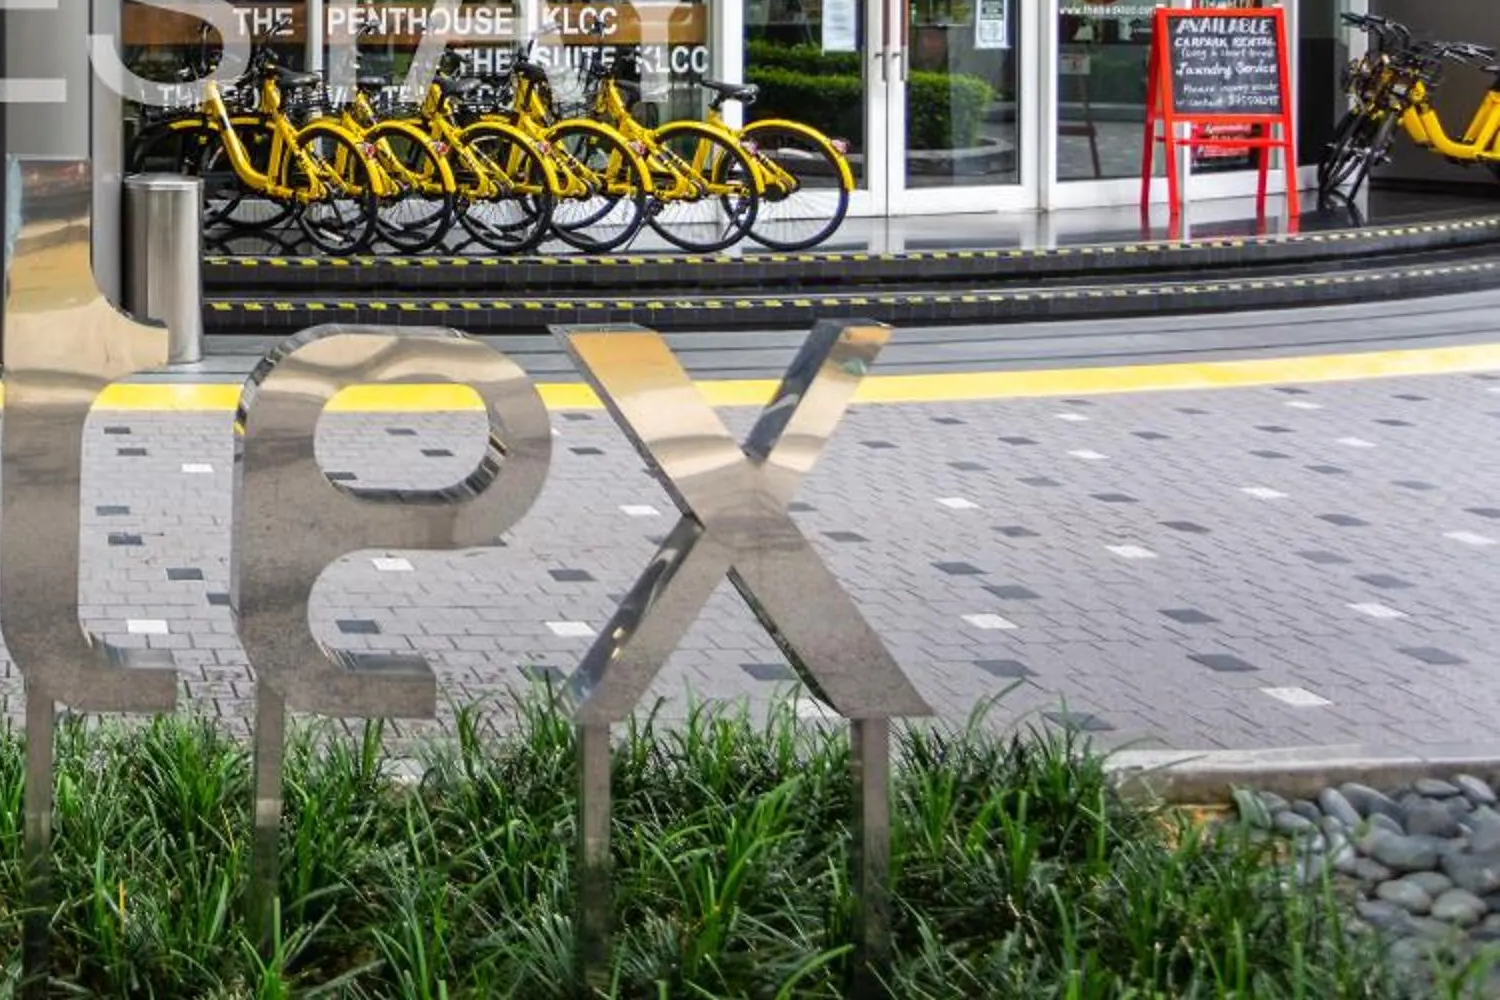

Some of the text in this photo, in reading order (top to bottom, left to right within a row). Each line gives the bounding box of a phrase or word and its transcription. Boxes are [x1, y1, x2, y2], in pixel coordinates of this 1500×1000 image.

[233, 6, 619, 36] THE PENTHOUSE KLCC
[1176, 18, 1273, 34] AVAILABLE
[1174, 37, 1227, 48] CARPARK
[459, 45, 710, 76] THE SUITE KLCC
